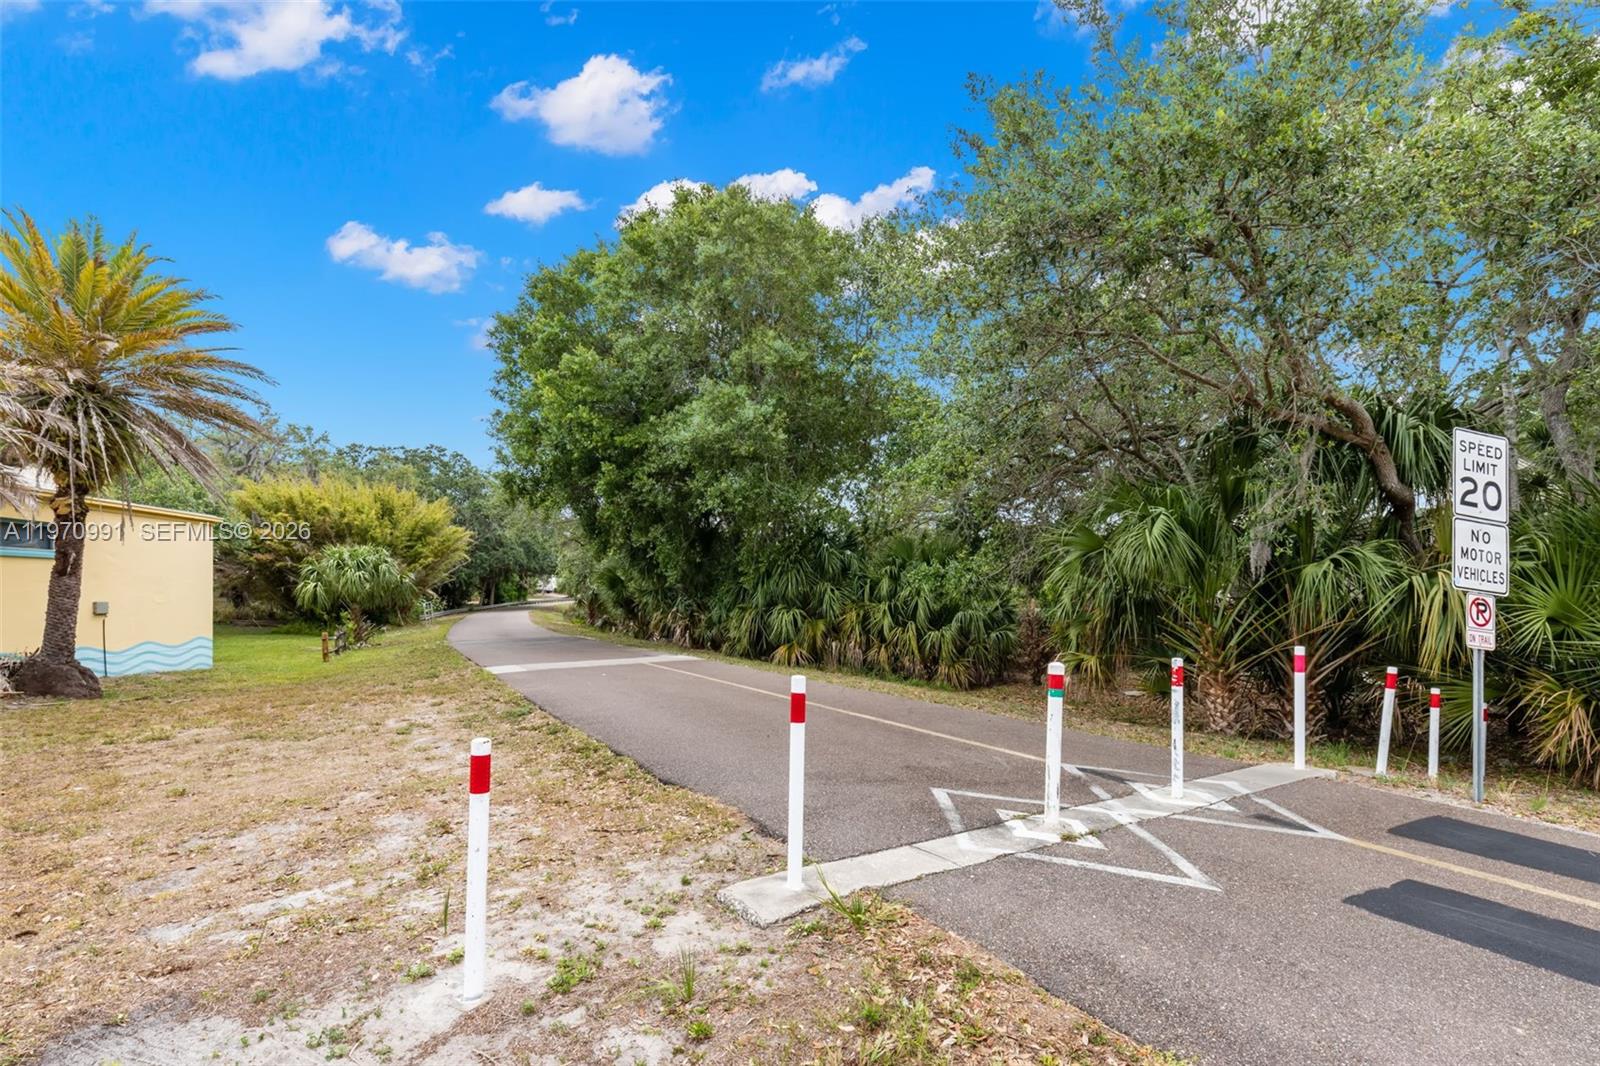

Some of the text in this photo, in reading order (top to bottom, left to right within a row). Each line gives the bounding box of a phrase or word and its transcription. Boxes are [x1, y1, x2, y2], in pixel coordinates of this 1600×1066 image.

[1459, 440, 1503, 460] SPEED
[1463, 458, 1498, 477] LIMIT
[1459, 476, 1502, 511] 20
[1471, 529, 1491, 544] NO
[1460, 546, 1502, 565] MOTOR
[1457, 565, 1505, 585] VEHICLES
[1469, 633, 1492, 646] ON TRAIL
